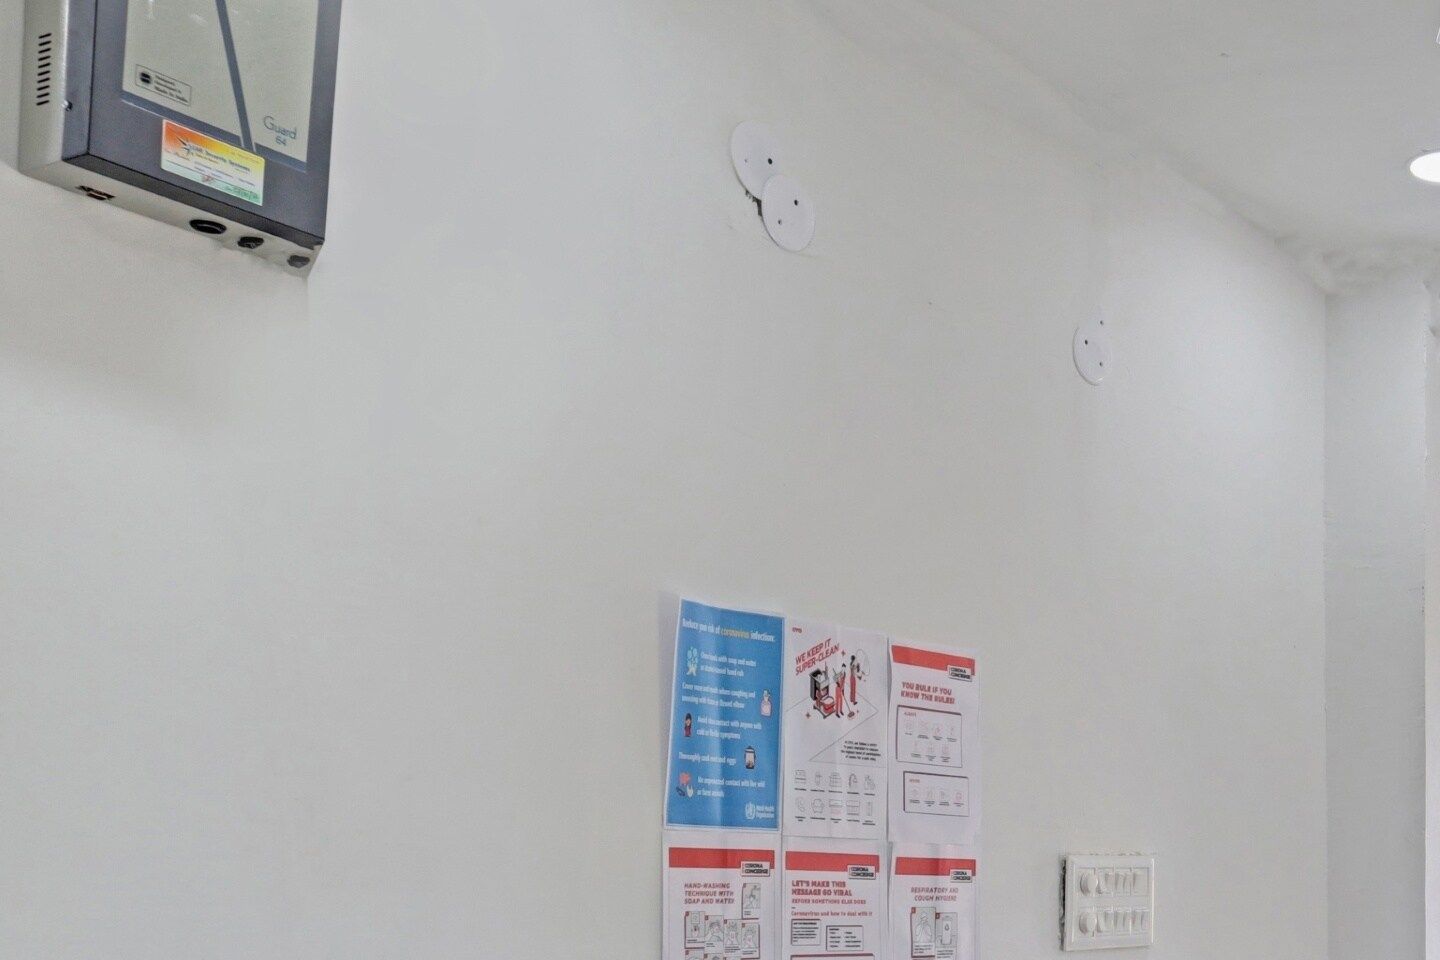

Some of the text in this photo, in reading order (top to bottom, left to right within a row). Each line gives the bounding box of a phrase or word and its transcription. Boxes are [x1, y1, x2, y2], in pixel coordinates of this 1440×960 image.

[263, 116, 297, 140] Guard
[796, 638, 832, 665] WE KEEP IT
[796, 643, 839, 676] SUPER-CLEAN
[901, 691, 920, 699] KNOW
[921, 693, 933, 701] THE
[902, 681, 914, 689] YOU
[915, 683, 931, 692] RULE
